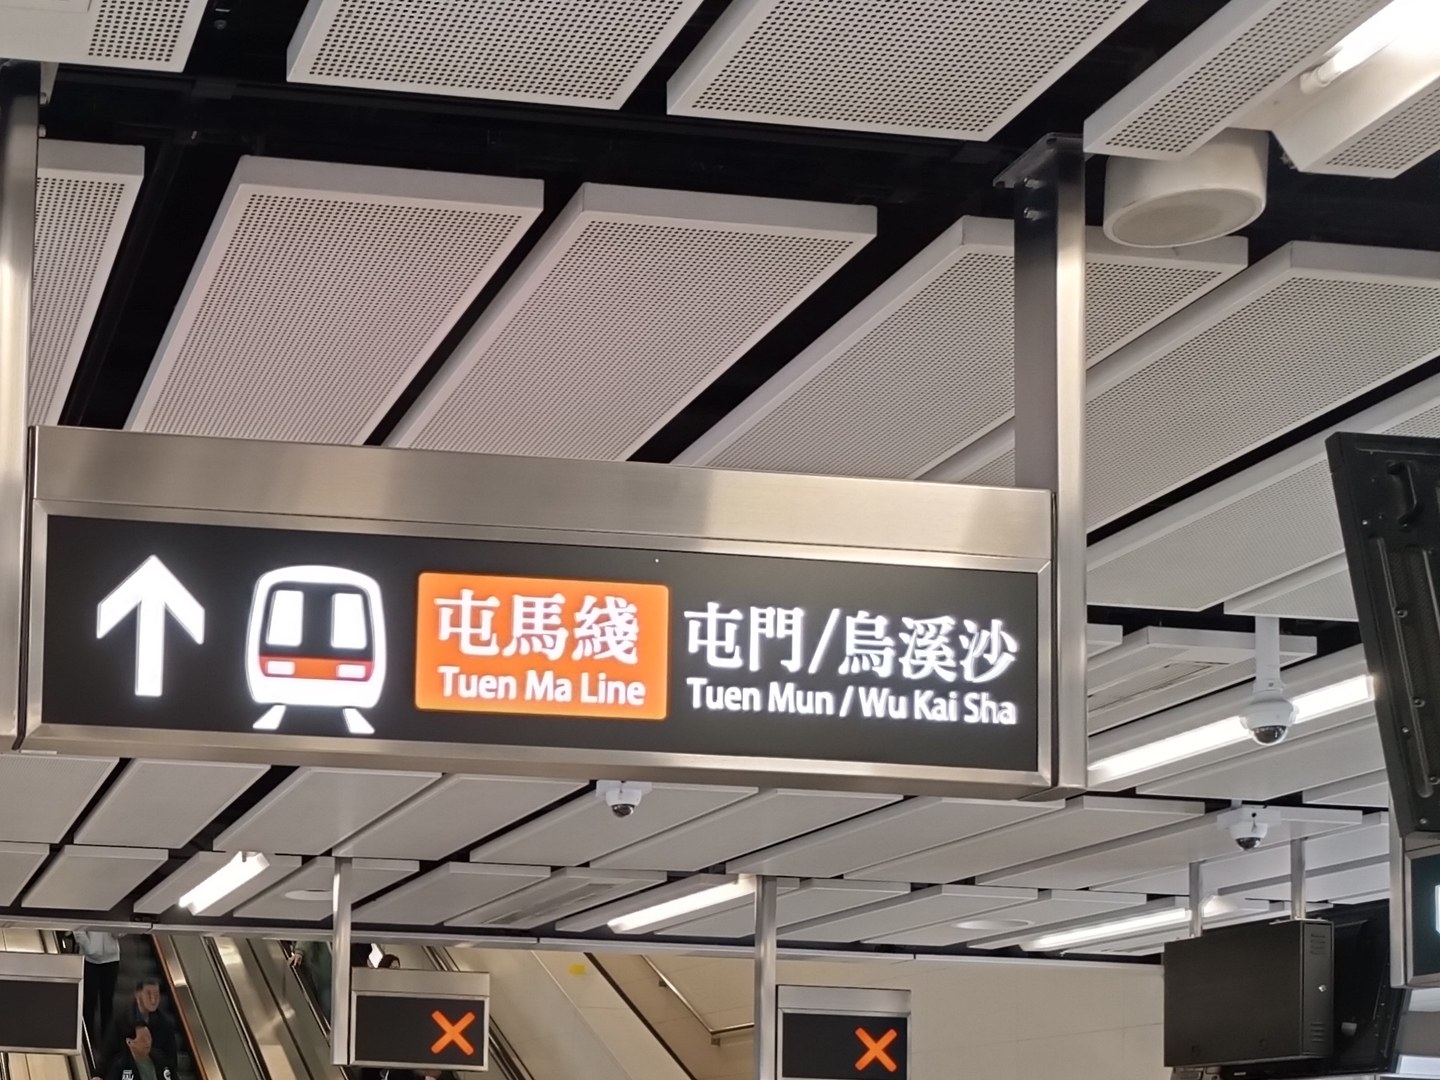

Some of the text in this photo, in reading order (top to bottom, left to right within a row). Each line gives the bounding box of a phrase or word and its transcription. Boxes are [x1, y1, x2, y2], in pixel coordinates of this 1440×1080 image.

[434, 588, 640, 664] 屯馬綫
[684, 602, 1019, 683] 屯門/烏溪沙
[438, 665, 646, 706] Tuen Ma Line
[686, 677, 762, 712] Tuen
[768, 681, 835, 717] Mun
[858, 686, 907, 719] Wu
[913, 690, 959, 722] Kai
[964, 693, 1017, 726] Sha
